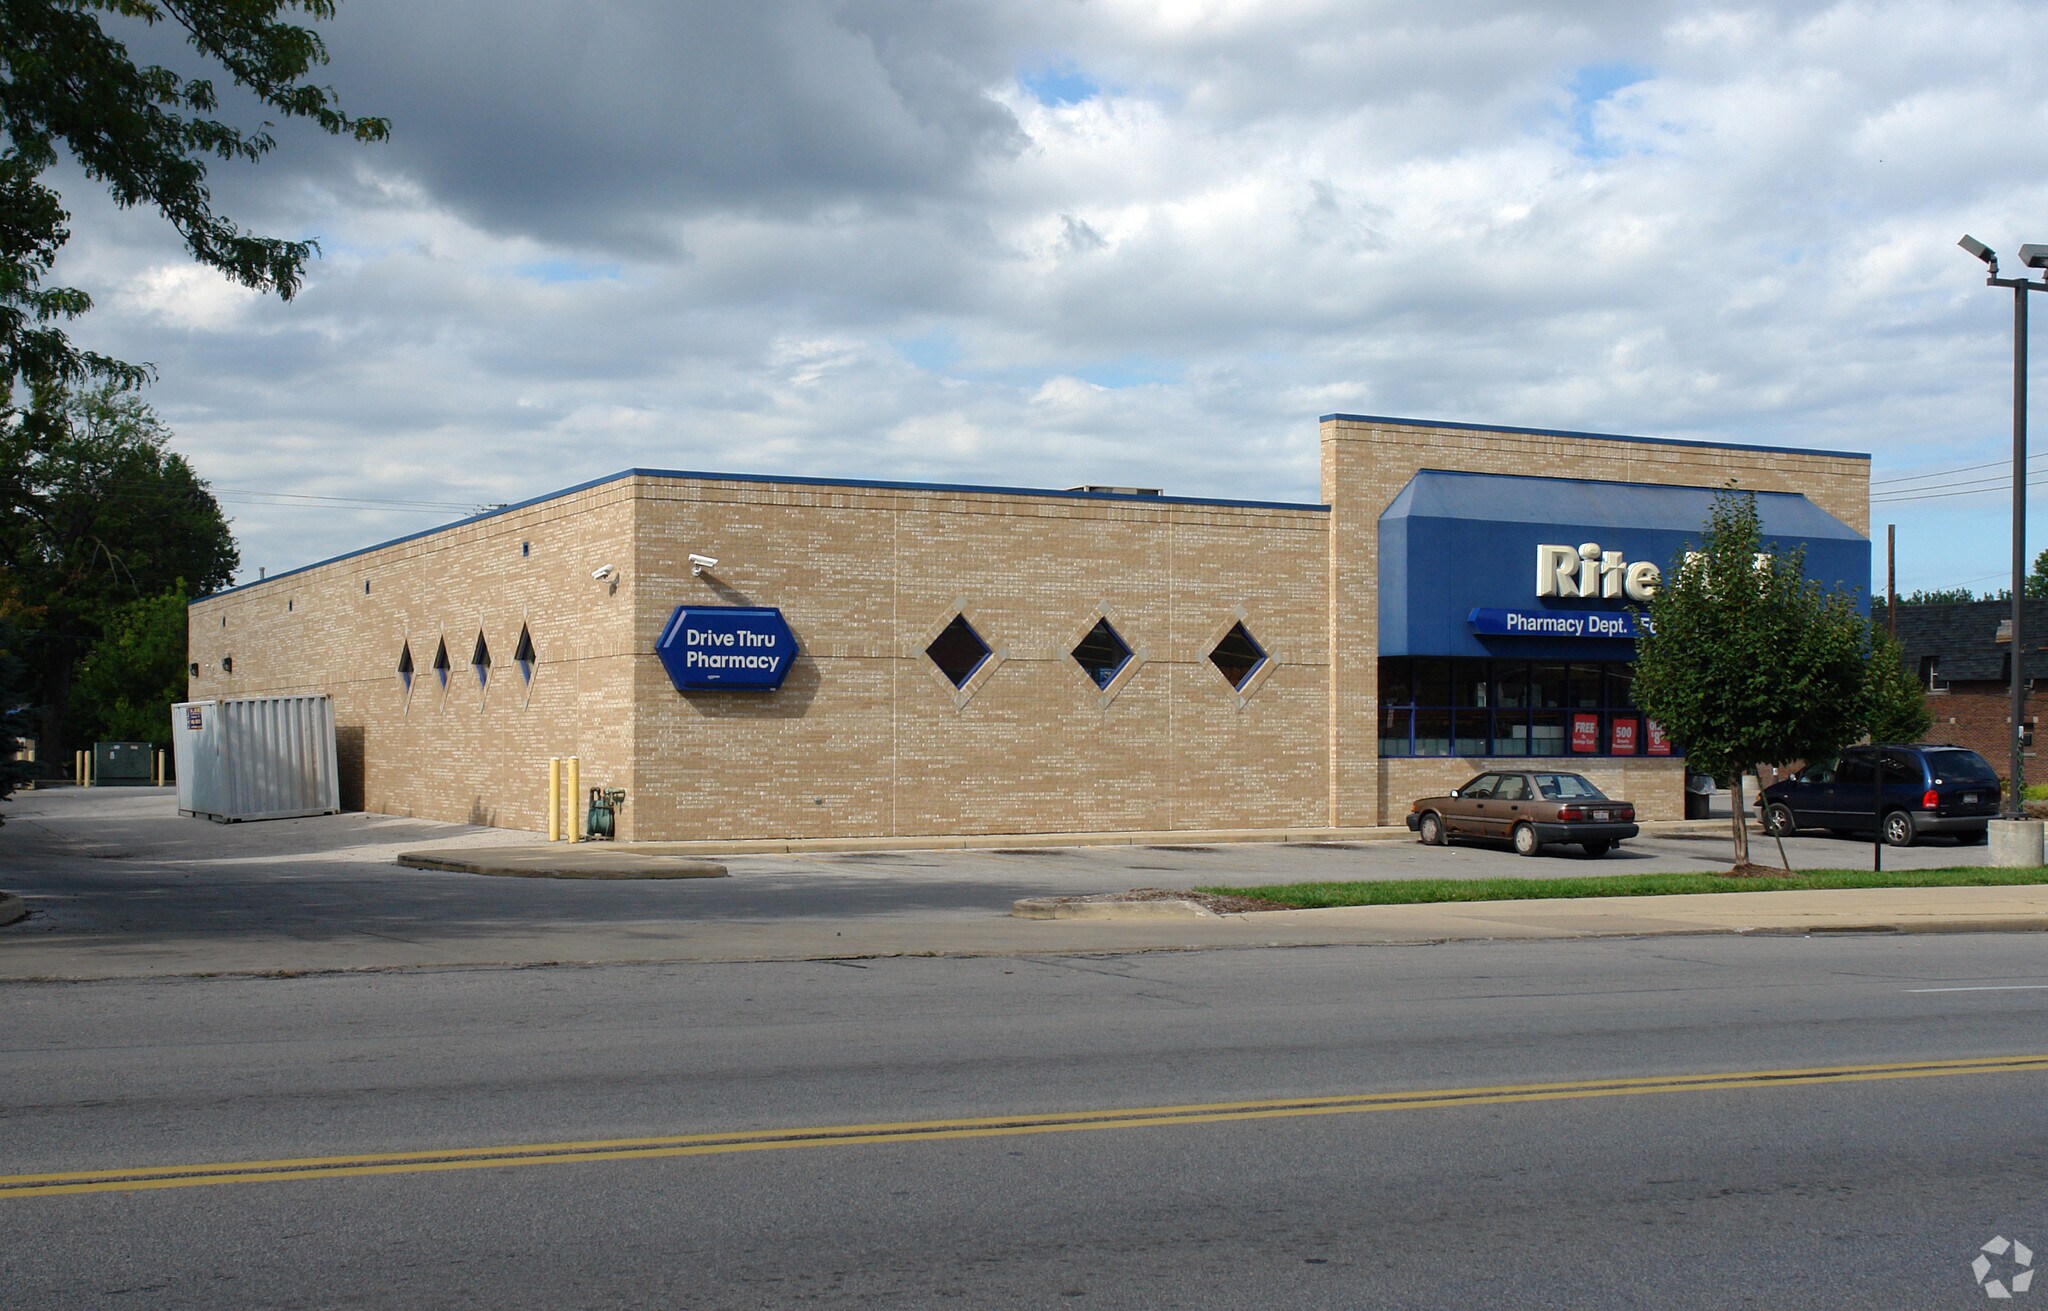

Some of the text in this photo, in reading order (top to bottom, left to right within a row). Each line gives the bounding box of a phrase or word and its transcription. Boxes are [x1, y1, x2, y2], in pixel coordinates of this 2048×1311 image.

[1536, 542, 1663, 602] Rite
[1506, 613, 1584, 636] Pharmacy
[1588, 615, 1628, 637] Dept.
[686, 629, 776, 647] Drive Thru
[686, 651, 780, 673] Pharmacy
[1575, 721, 1595, 733] FREE
[1615, 726, 1632, 738] 500
